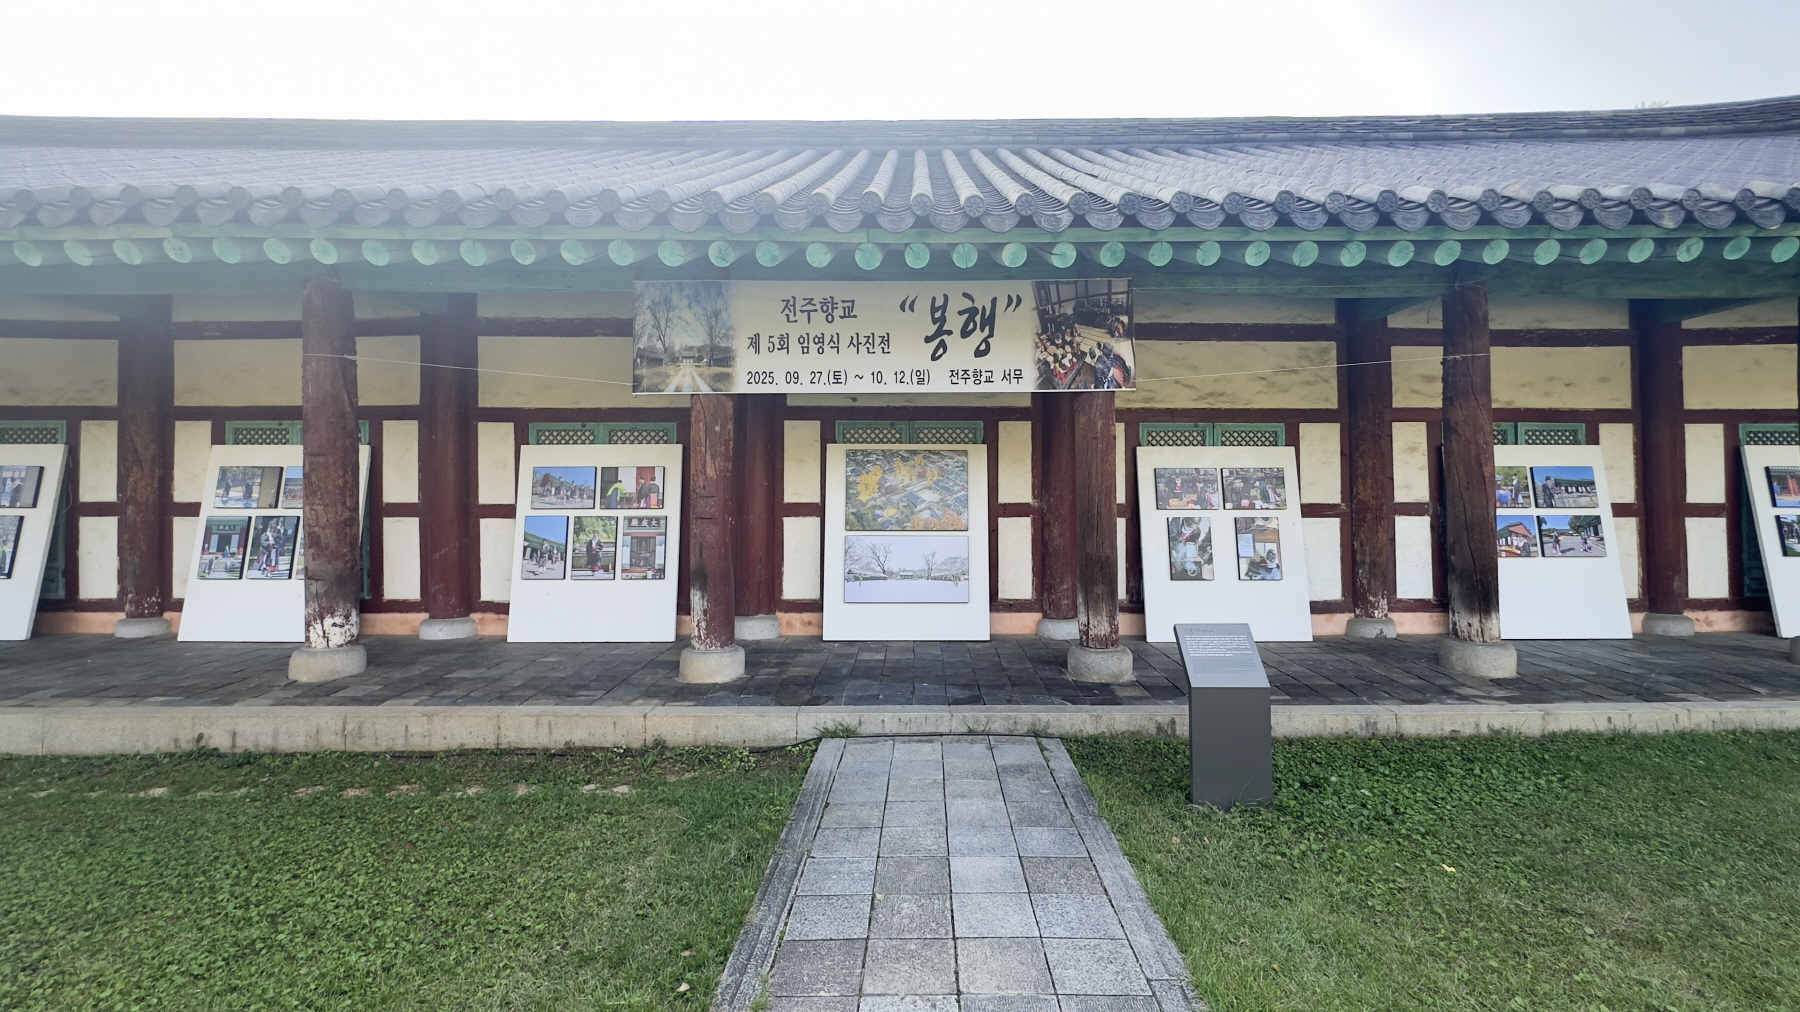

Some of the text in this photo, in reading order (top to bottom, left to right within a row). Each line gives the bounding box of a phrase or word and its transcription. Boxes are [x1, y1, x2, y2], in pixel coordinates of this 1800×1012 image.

[780, 295, 858, 324] 전주향교
[746, 332, 891, 355] 제 5회 임영식 사진전
[746, 370, 779, 386] 2025.
[785, 370, 803, 386] 09.
[809, 368, 848, 386] 27.(토)
[870, 370, 887, 386] 10.
[893, 368, 931, 386] 12.(일)
[948, 368, 1024, 385] 전주향교 서무
